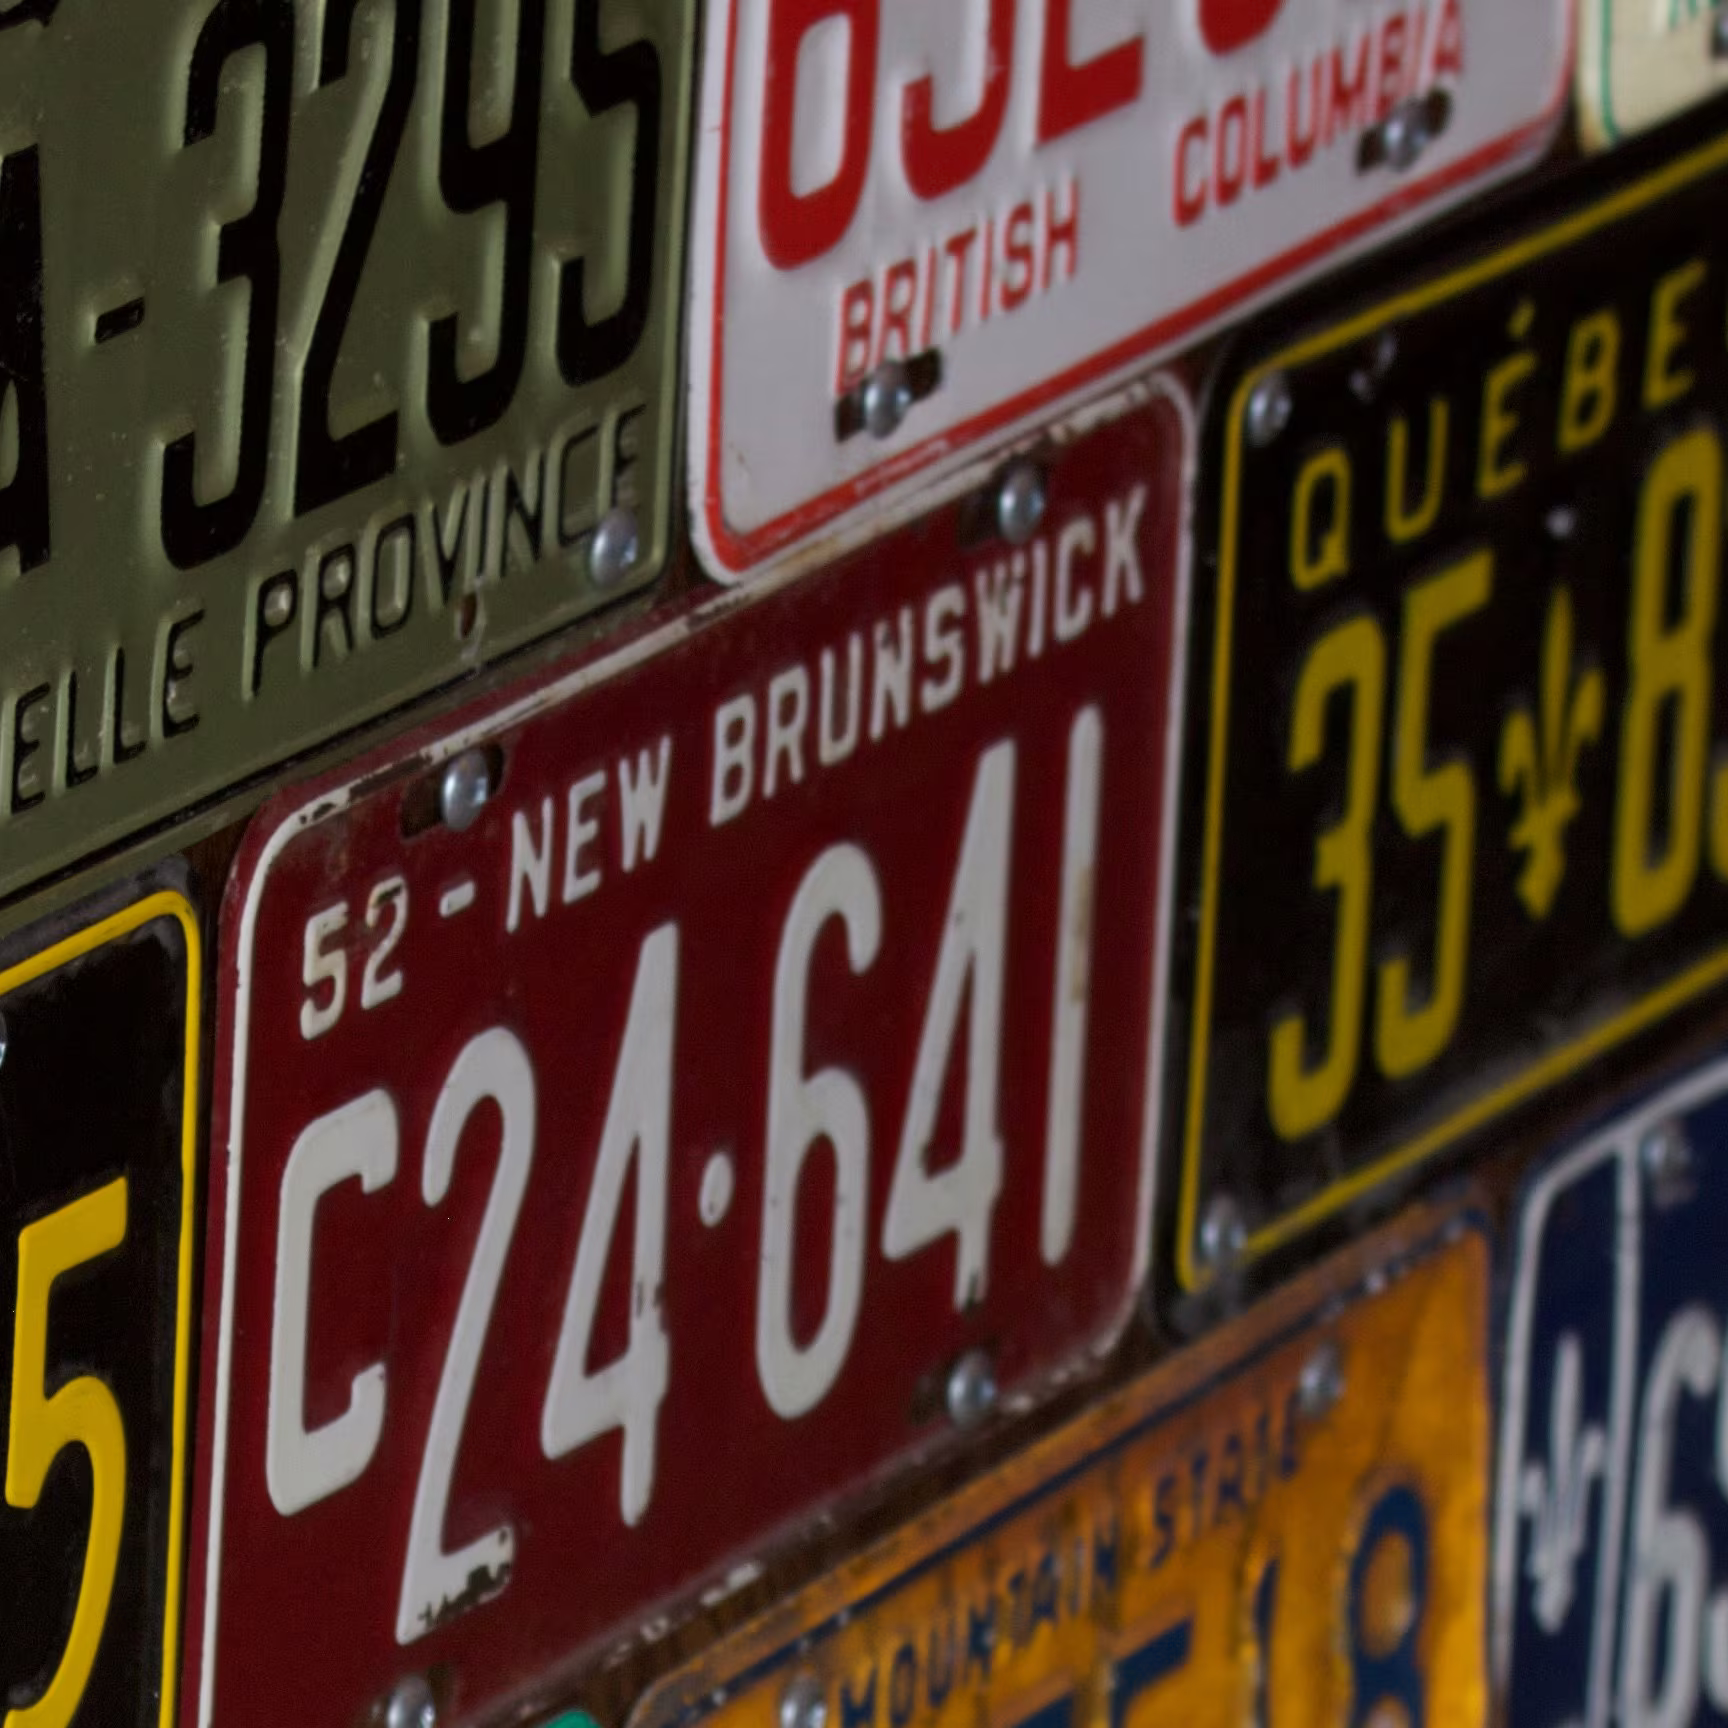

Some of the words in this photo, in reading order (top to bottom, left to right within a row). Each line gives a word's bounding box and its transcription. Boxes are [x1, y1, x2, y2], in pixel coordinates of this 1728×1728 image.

[834, 178, 1081, 396] BRITISH
[1172, 2, 1466, 229] COLUMBIA
[246, 404, 648, 701] PROVINCE
[707, 483, 1149, 827] BRUNSWICK
